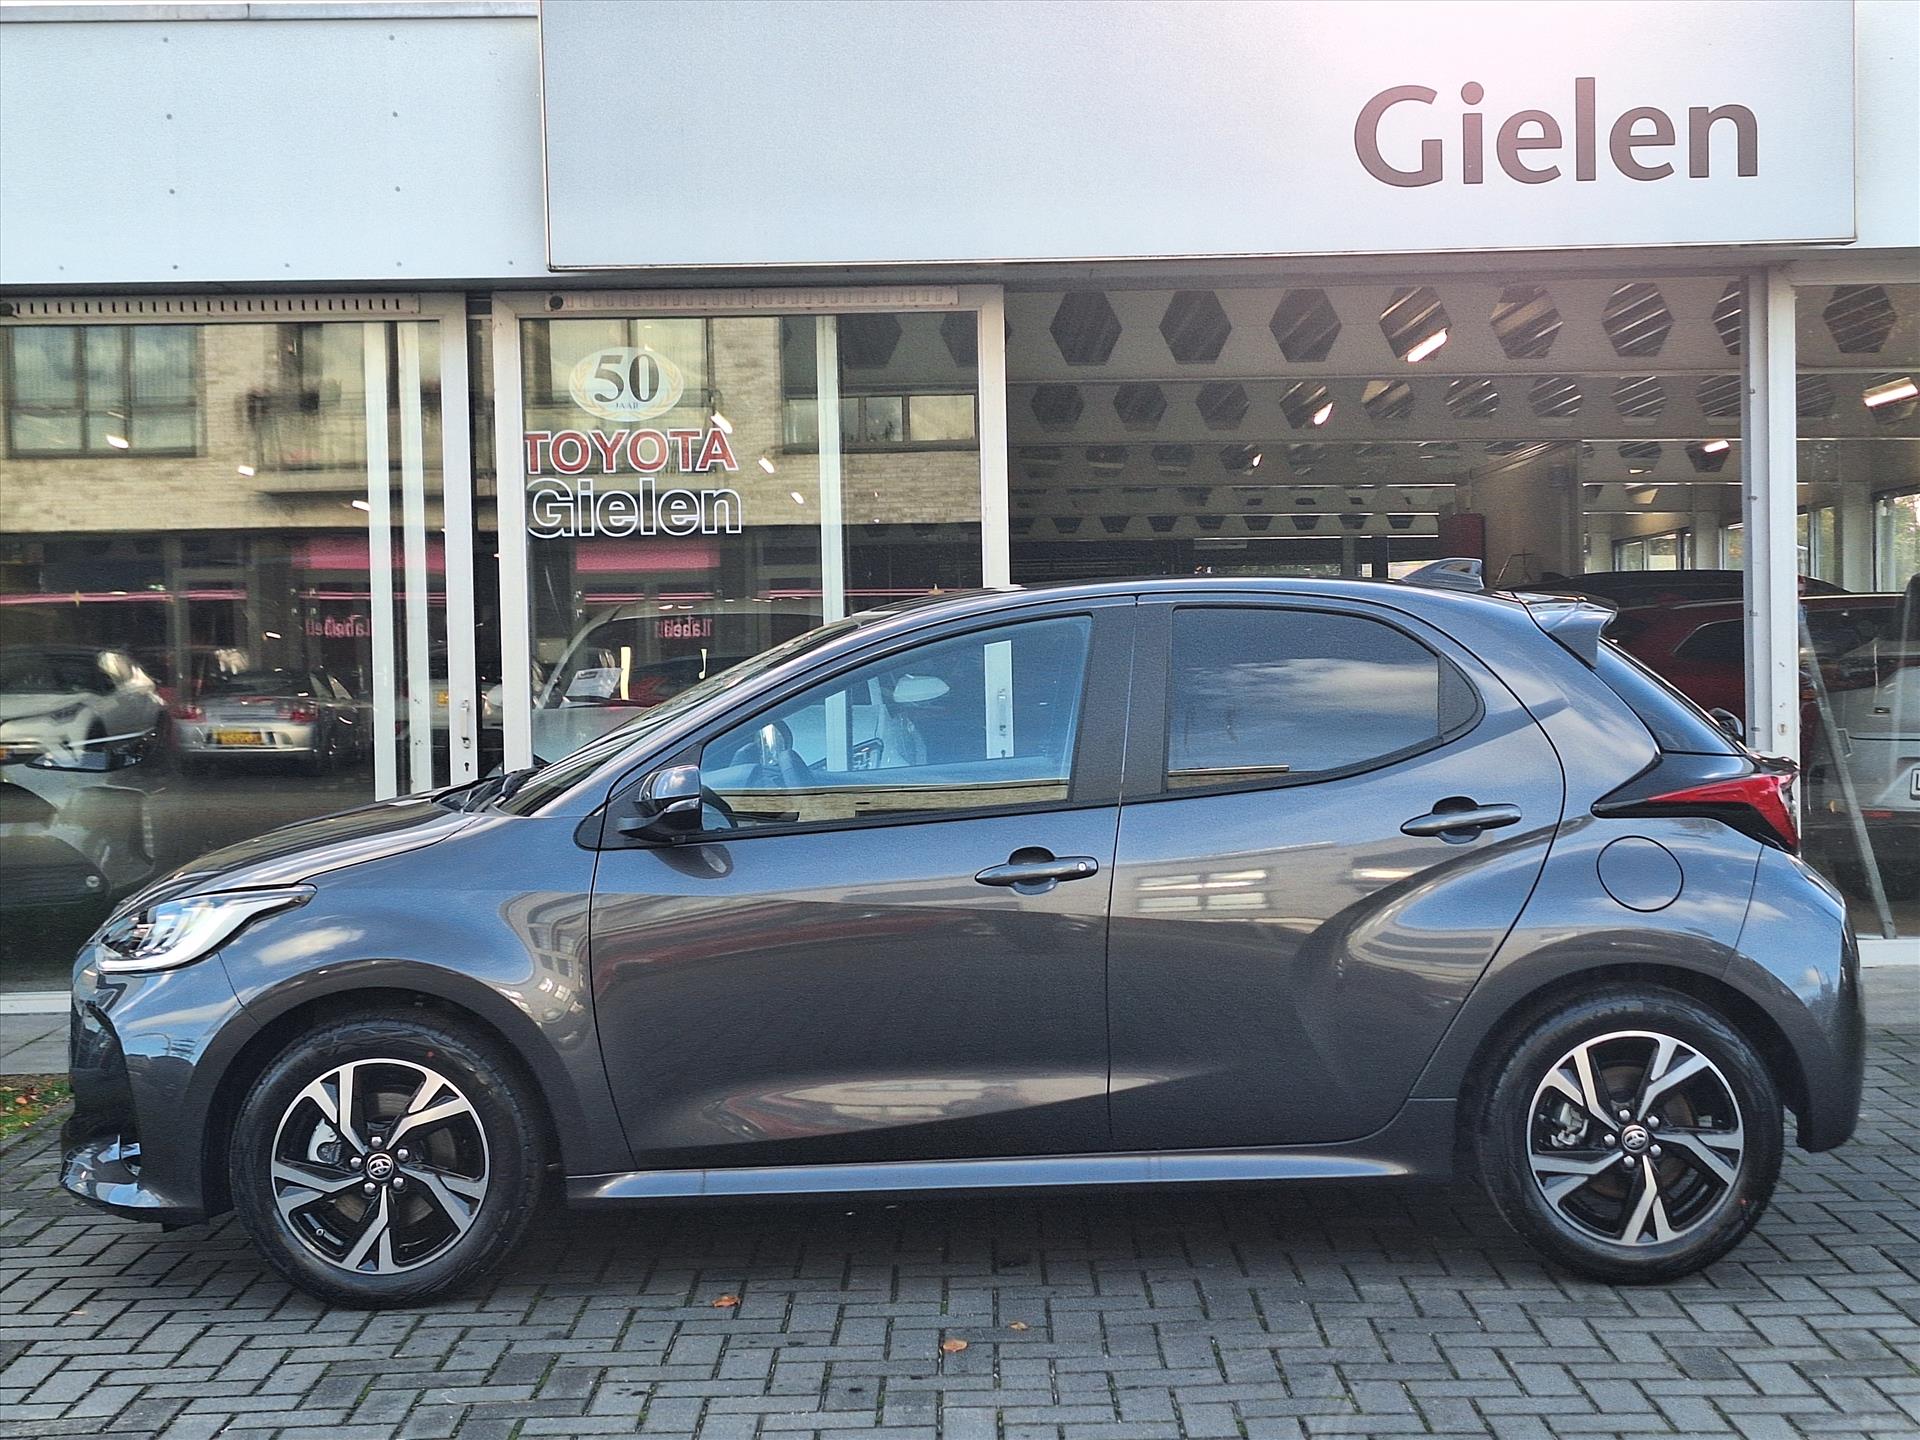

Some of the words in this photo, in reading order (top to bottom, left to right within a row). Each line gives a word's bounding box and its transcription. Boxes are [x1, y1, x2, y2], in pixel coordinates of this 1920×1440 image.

[1354, 77, 1758, 188] Gielen
[594, 354, 659, 402] 50
[525, 428, 739, 474] TOYOTA
[526, 478, 742, 538] Gielen
